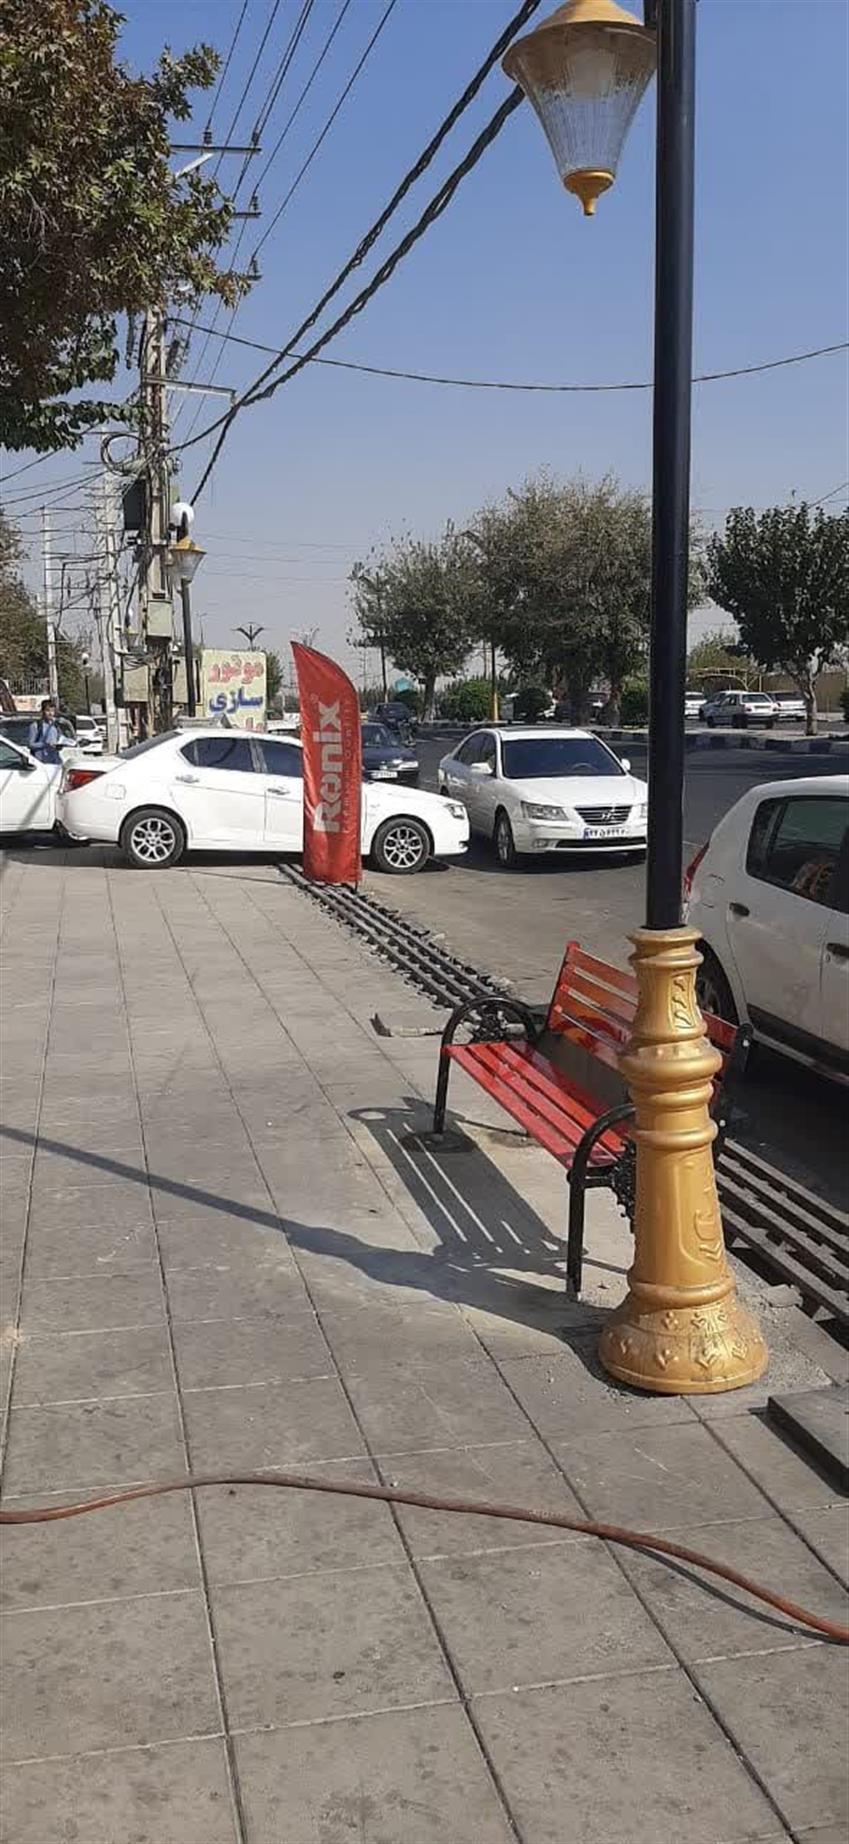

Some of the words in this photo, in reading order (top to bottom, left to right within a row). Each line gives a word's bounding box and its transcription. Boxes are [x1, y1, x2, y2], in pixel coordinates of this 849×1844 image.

[208, 655, 264, 684] موتور
[209, 686, 263, 714] سازی
[313, 701, 343, 832] Ronix
